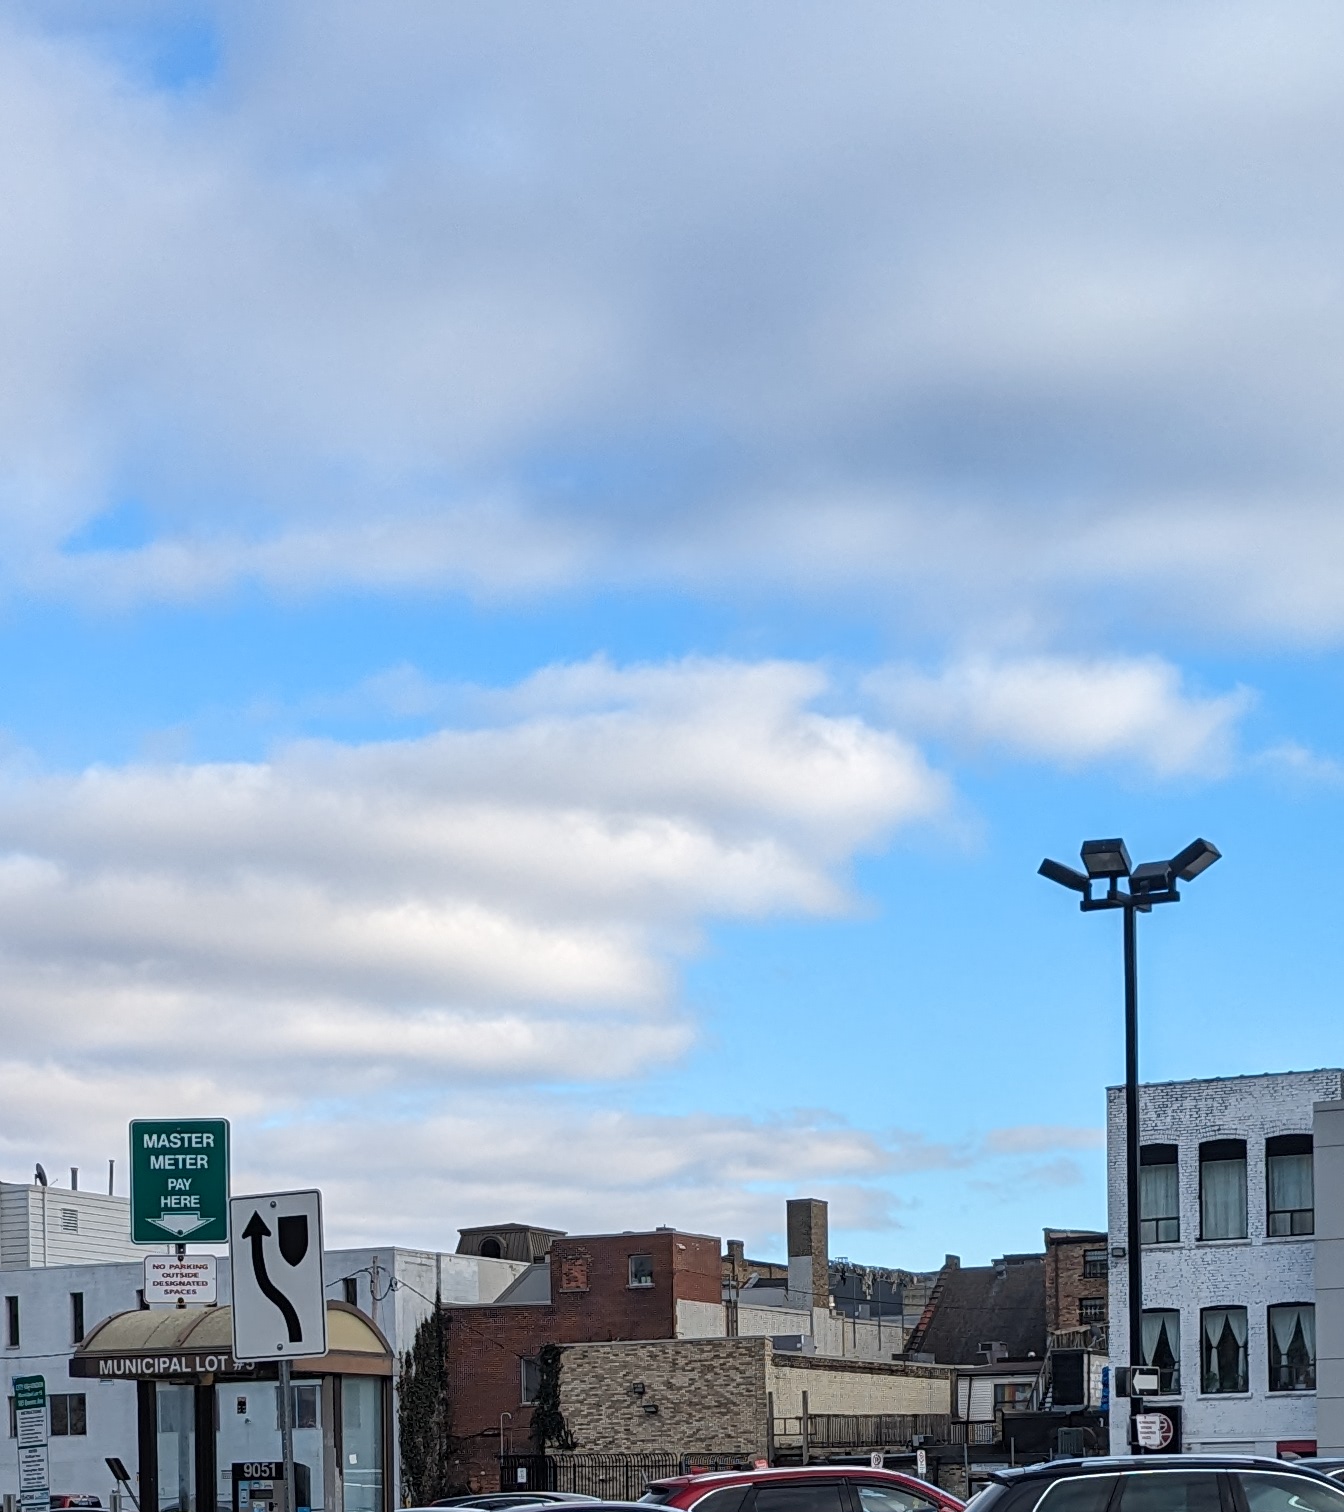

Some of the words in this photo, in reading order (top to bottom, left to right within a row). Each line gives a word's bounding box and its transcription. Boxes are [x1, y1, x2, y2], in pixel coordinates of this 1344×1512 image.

[143, 1133, 215, 1149] MASTER
[150, 1154, 209, 1170] METER
[167, 1178, 193, 1191] PAY
[160, 1195, 201, 1208] HERE
[99, 1356, 192, 1375] MUNICIPAL
[195, 1355, 229, 1372] LOT
[243, 1462, 277, 1478] 9051
